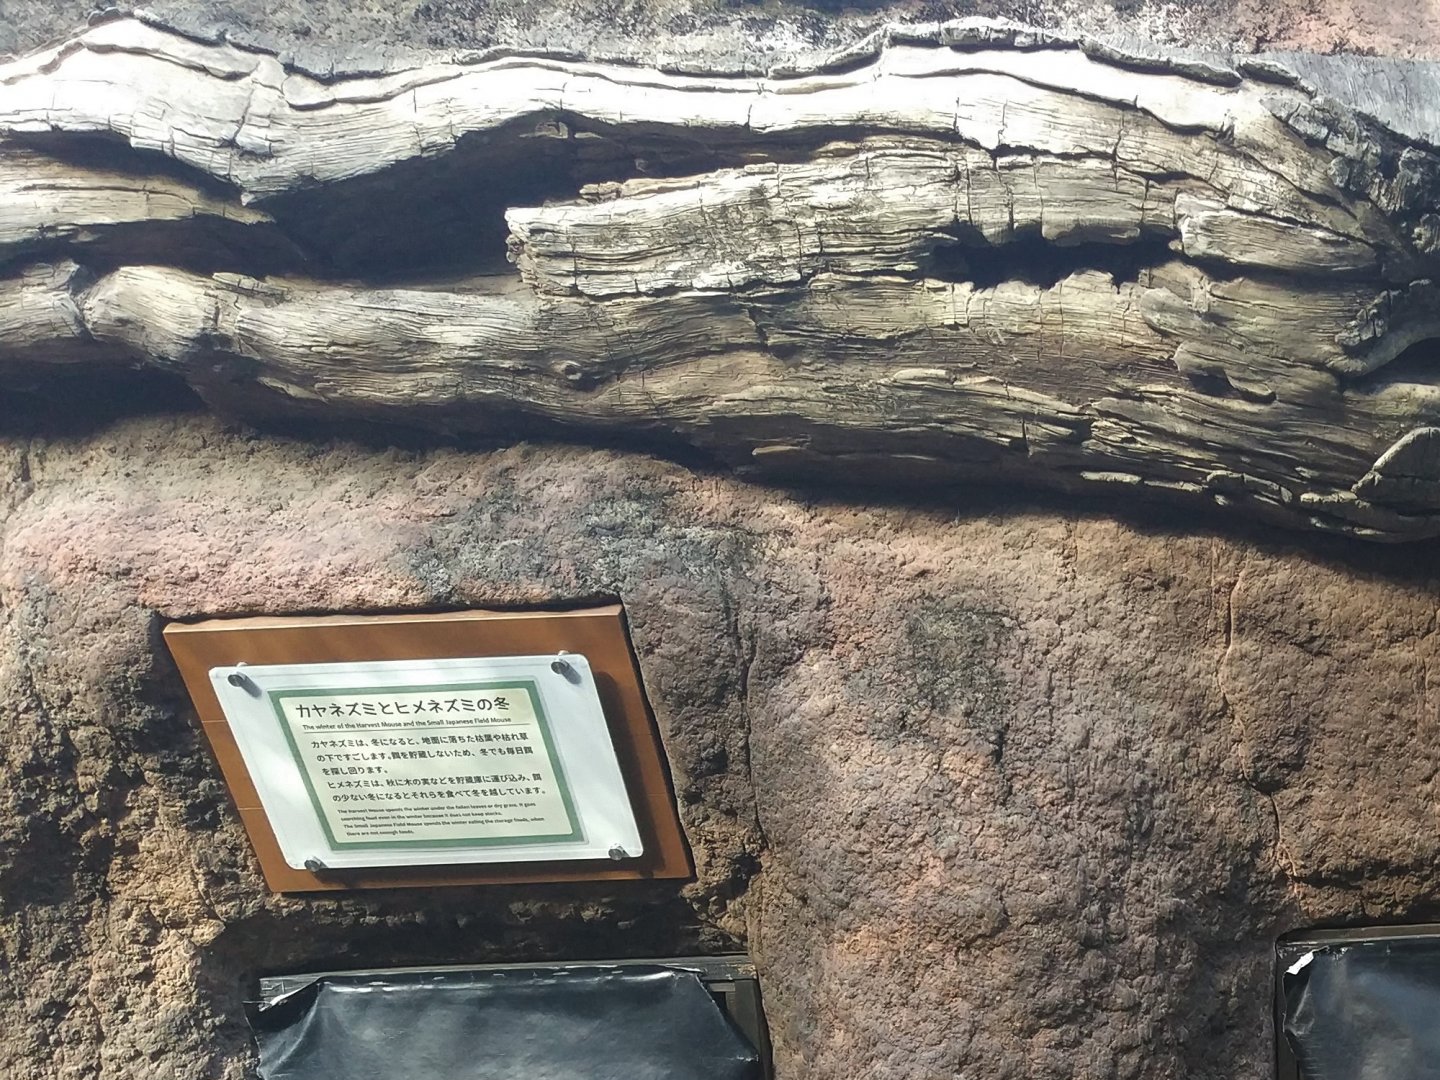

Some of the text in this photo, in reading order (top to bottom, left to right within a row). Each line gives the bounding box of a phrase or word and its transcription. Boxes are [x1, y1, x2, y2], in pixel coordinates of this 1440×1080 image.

[296, 696, 510, 718] カヤネズミとヒメネズミの冬
[356, 721, 380, 729] Harvest
[446, 718, 474, 726] Japanese
